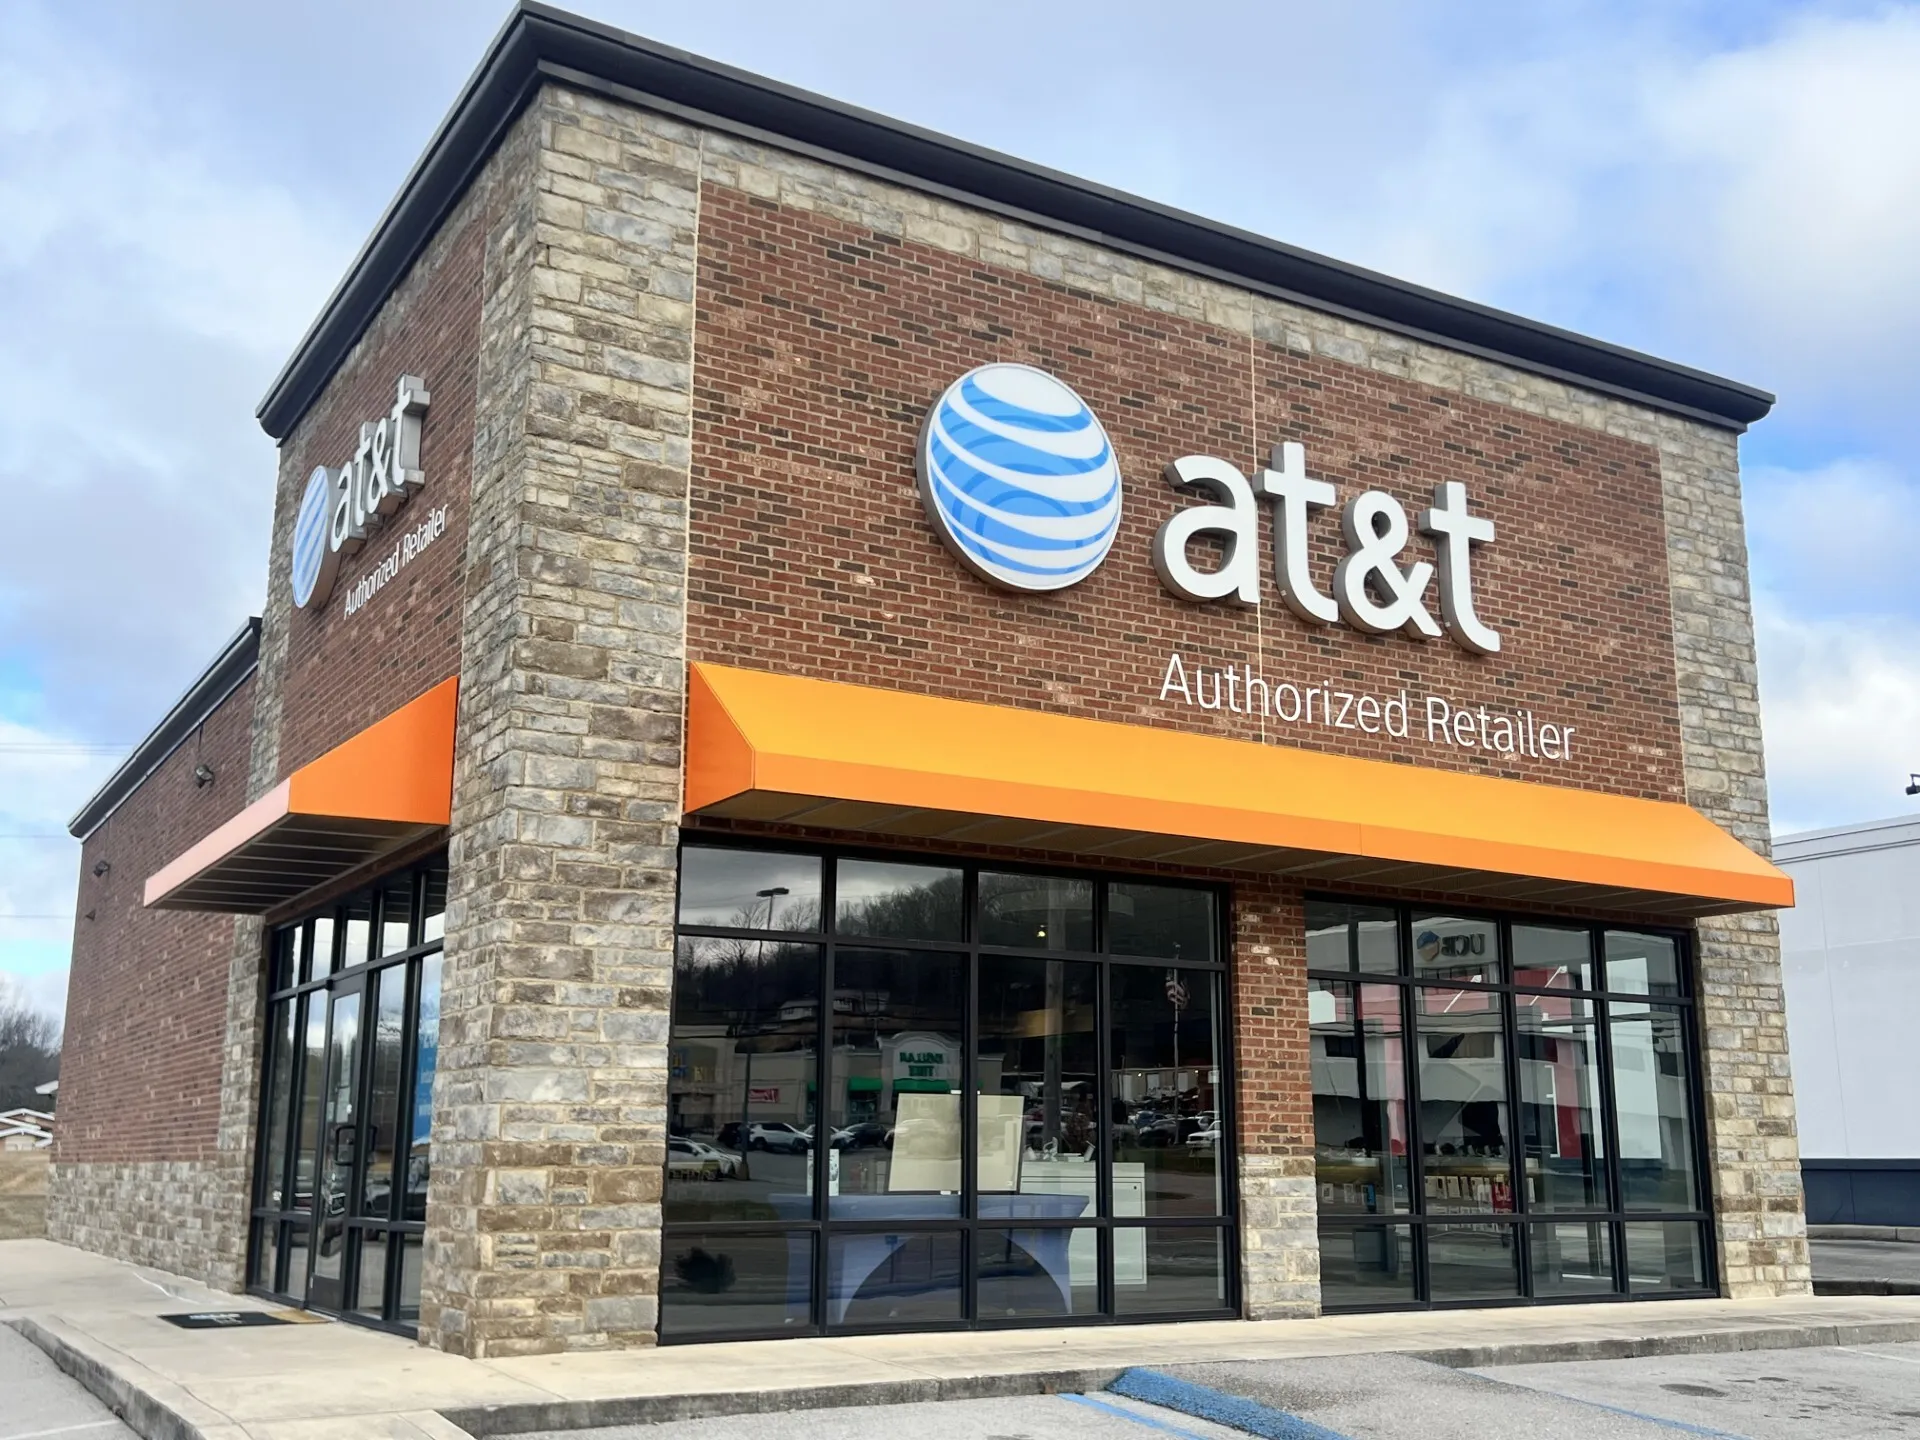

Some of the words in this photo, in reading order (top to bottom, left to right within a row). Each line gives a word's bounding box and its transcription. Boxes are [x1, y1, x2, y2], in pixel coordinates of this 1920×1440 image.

[331, 374, 430, 553] at&t
[343, 542, 400, 620] Authorized
[402, 504, 449, 567] Retailer
[1153, 441, 1500, 654] at&t
[1159, 653, 1408, 738] Authorized
[1426, 696, 1577, 761] Retailer
